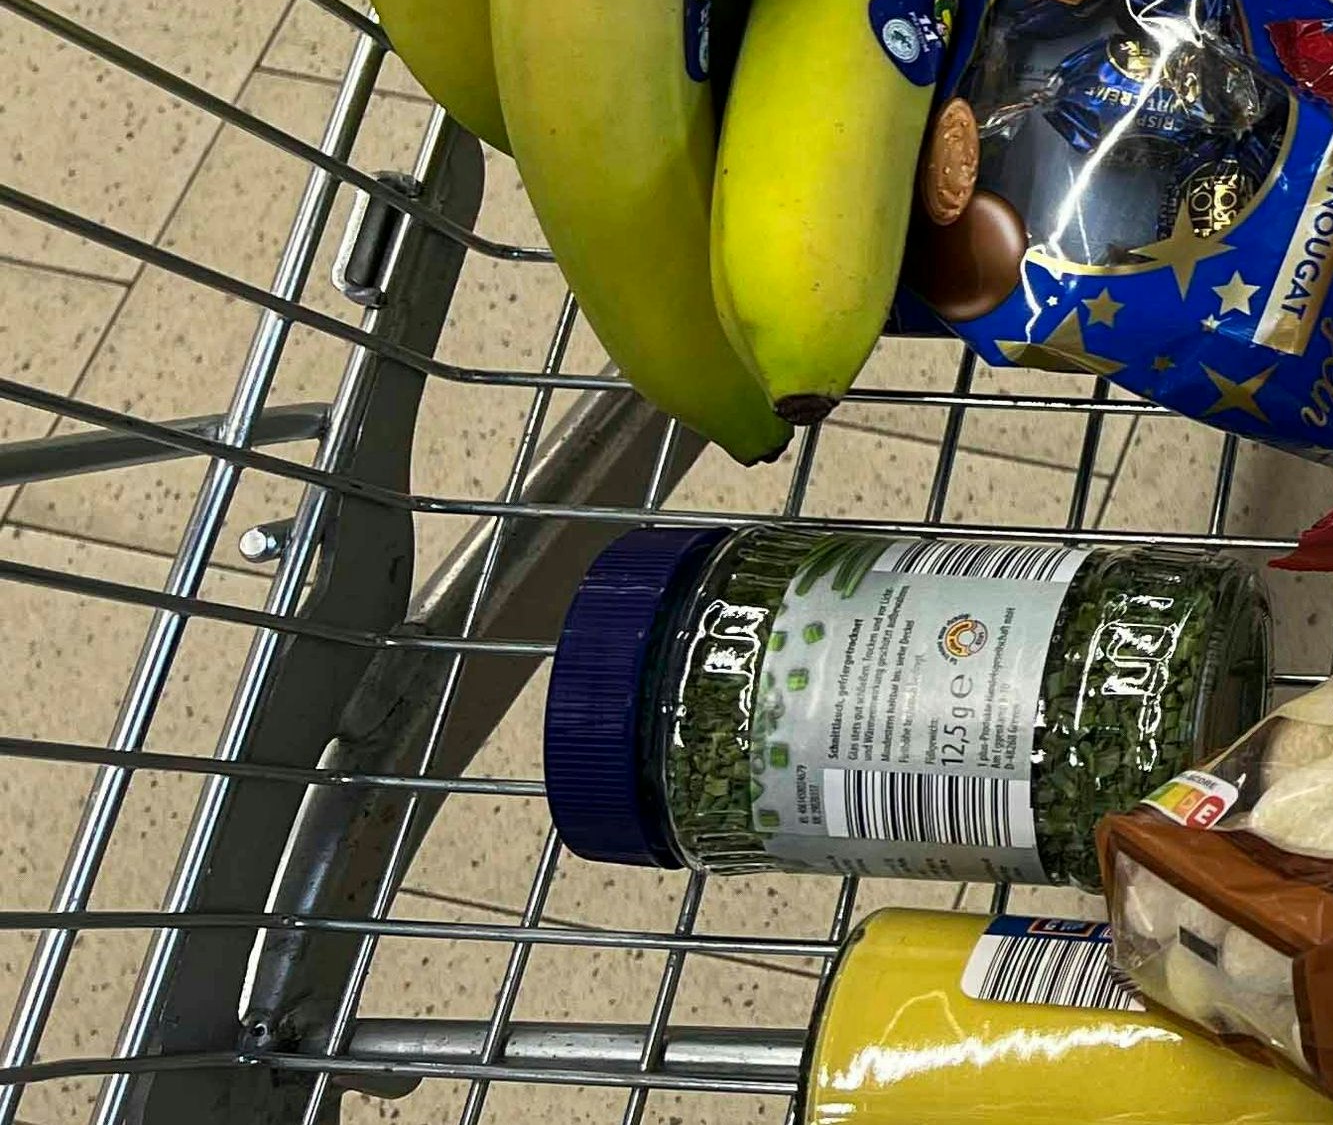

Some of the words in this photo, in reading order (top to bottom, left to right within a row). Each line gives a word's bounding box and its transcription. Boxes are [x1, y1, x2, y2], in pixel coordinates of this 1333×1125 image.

[838, 616, 862, 697] gefriergetrocknet
[949, 703, 976, 720] g
[940, 723, 970, 767] 12,5
